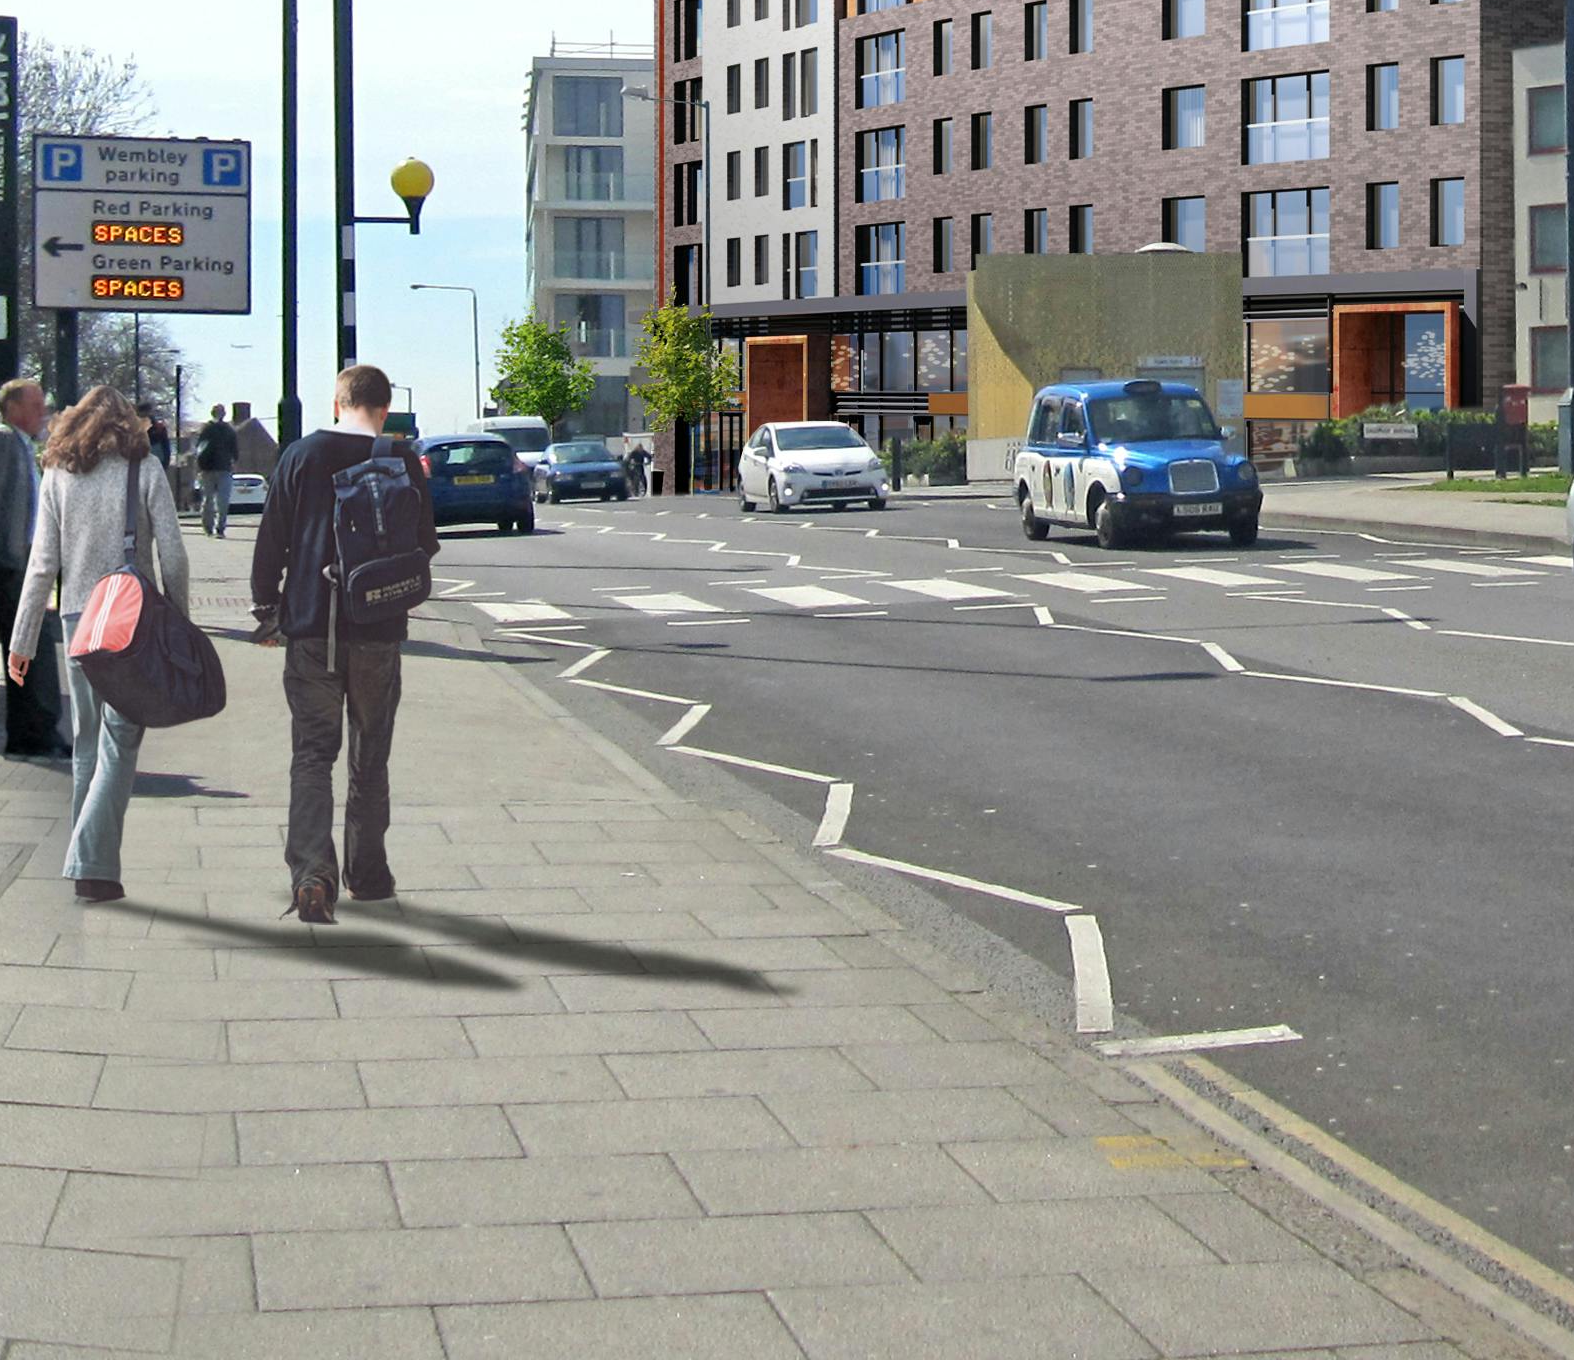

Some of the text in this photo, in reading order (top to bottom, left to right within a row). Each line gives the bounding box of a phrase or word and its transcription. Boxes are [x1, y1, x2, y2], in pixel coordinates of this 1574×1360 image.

[97, 146, 188, 167] Wembley
[105, 168, 180, 186] parking
[93, 199, 214, 220] Red Parking
[94, 225, 182, 244] SPACES
[92, 254, 235, 275] Green Parking
[94, 279, 182, 298] SPACES
